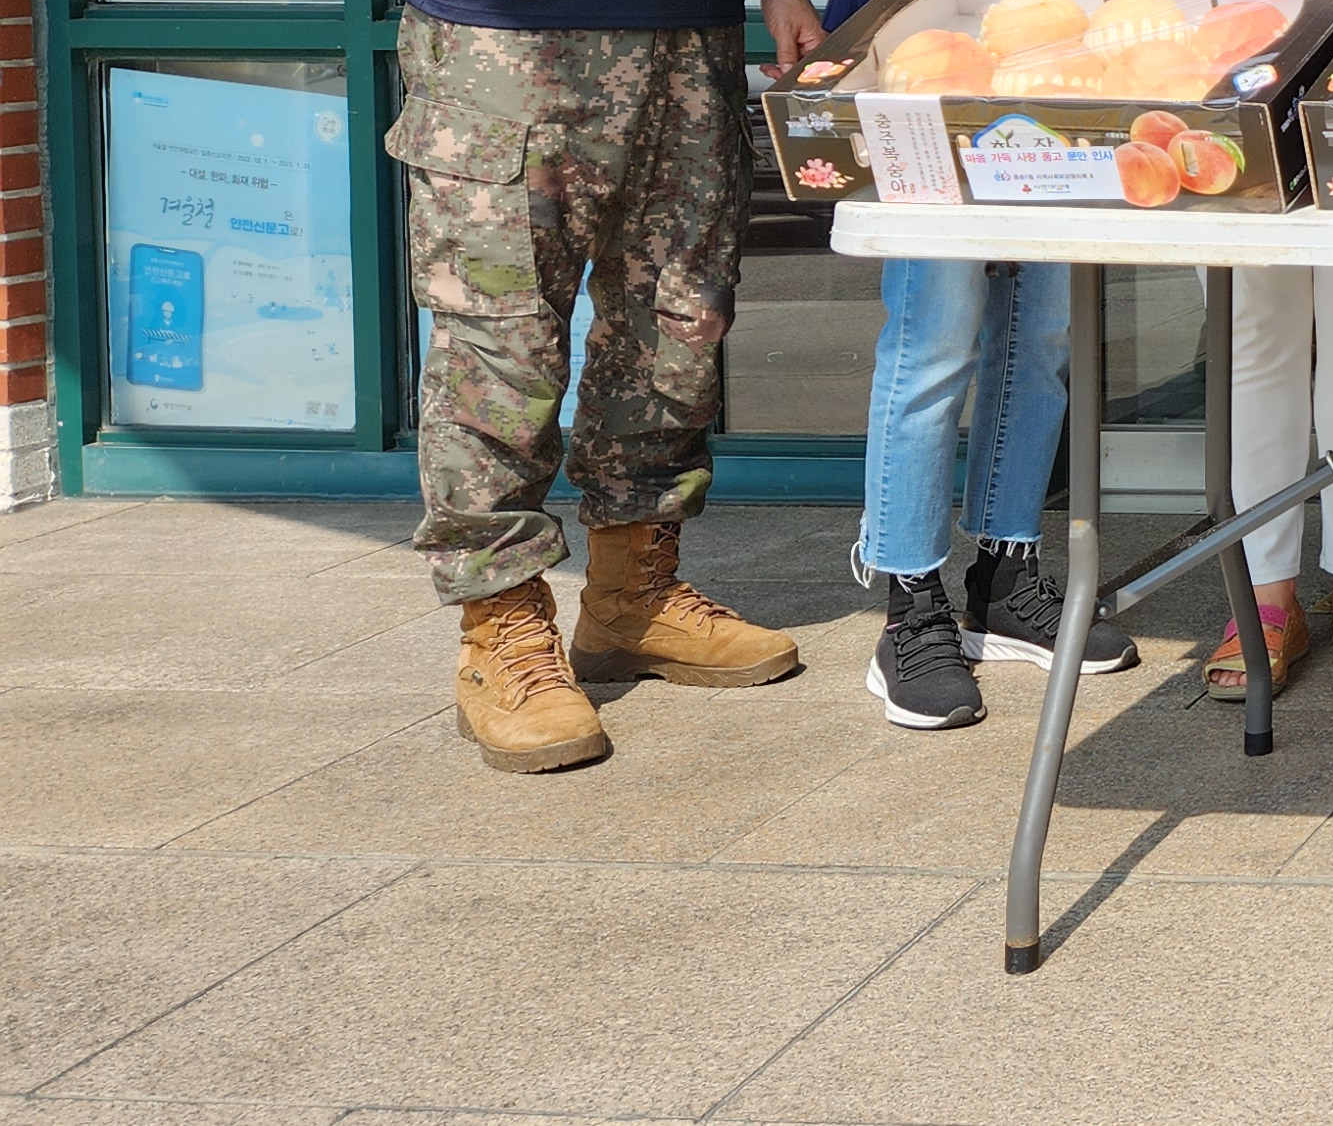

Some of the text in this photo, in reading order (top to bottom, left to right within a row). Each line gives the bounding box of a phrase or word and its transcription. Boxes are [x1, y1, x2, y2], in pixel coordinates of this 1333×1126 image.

[874, 112, 908, 195] 충주복숭아
[232, 175, 249, 186] 화재
[251, 177, 269, 189] 위험
[160, 196, 215, 229] 겨울철
[230, 217, 303, 237] 안전신문고로!
